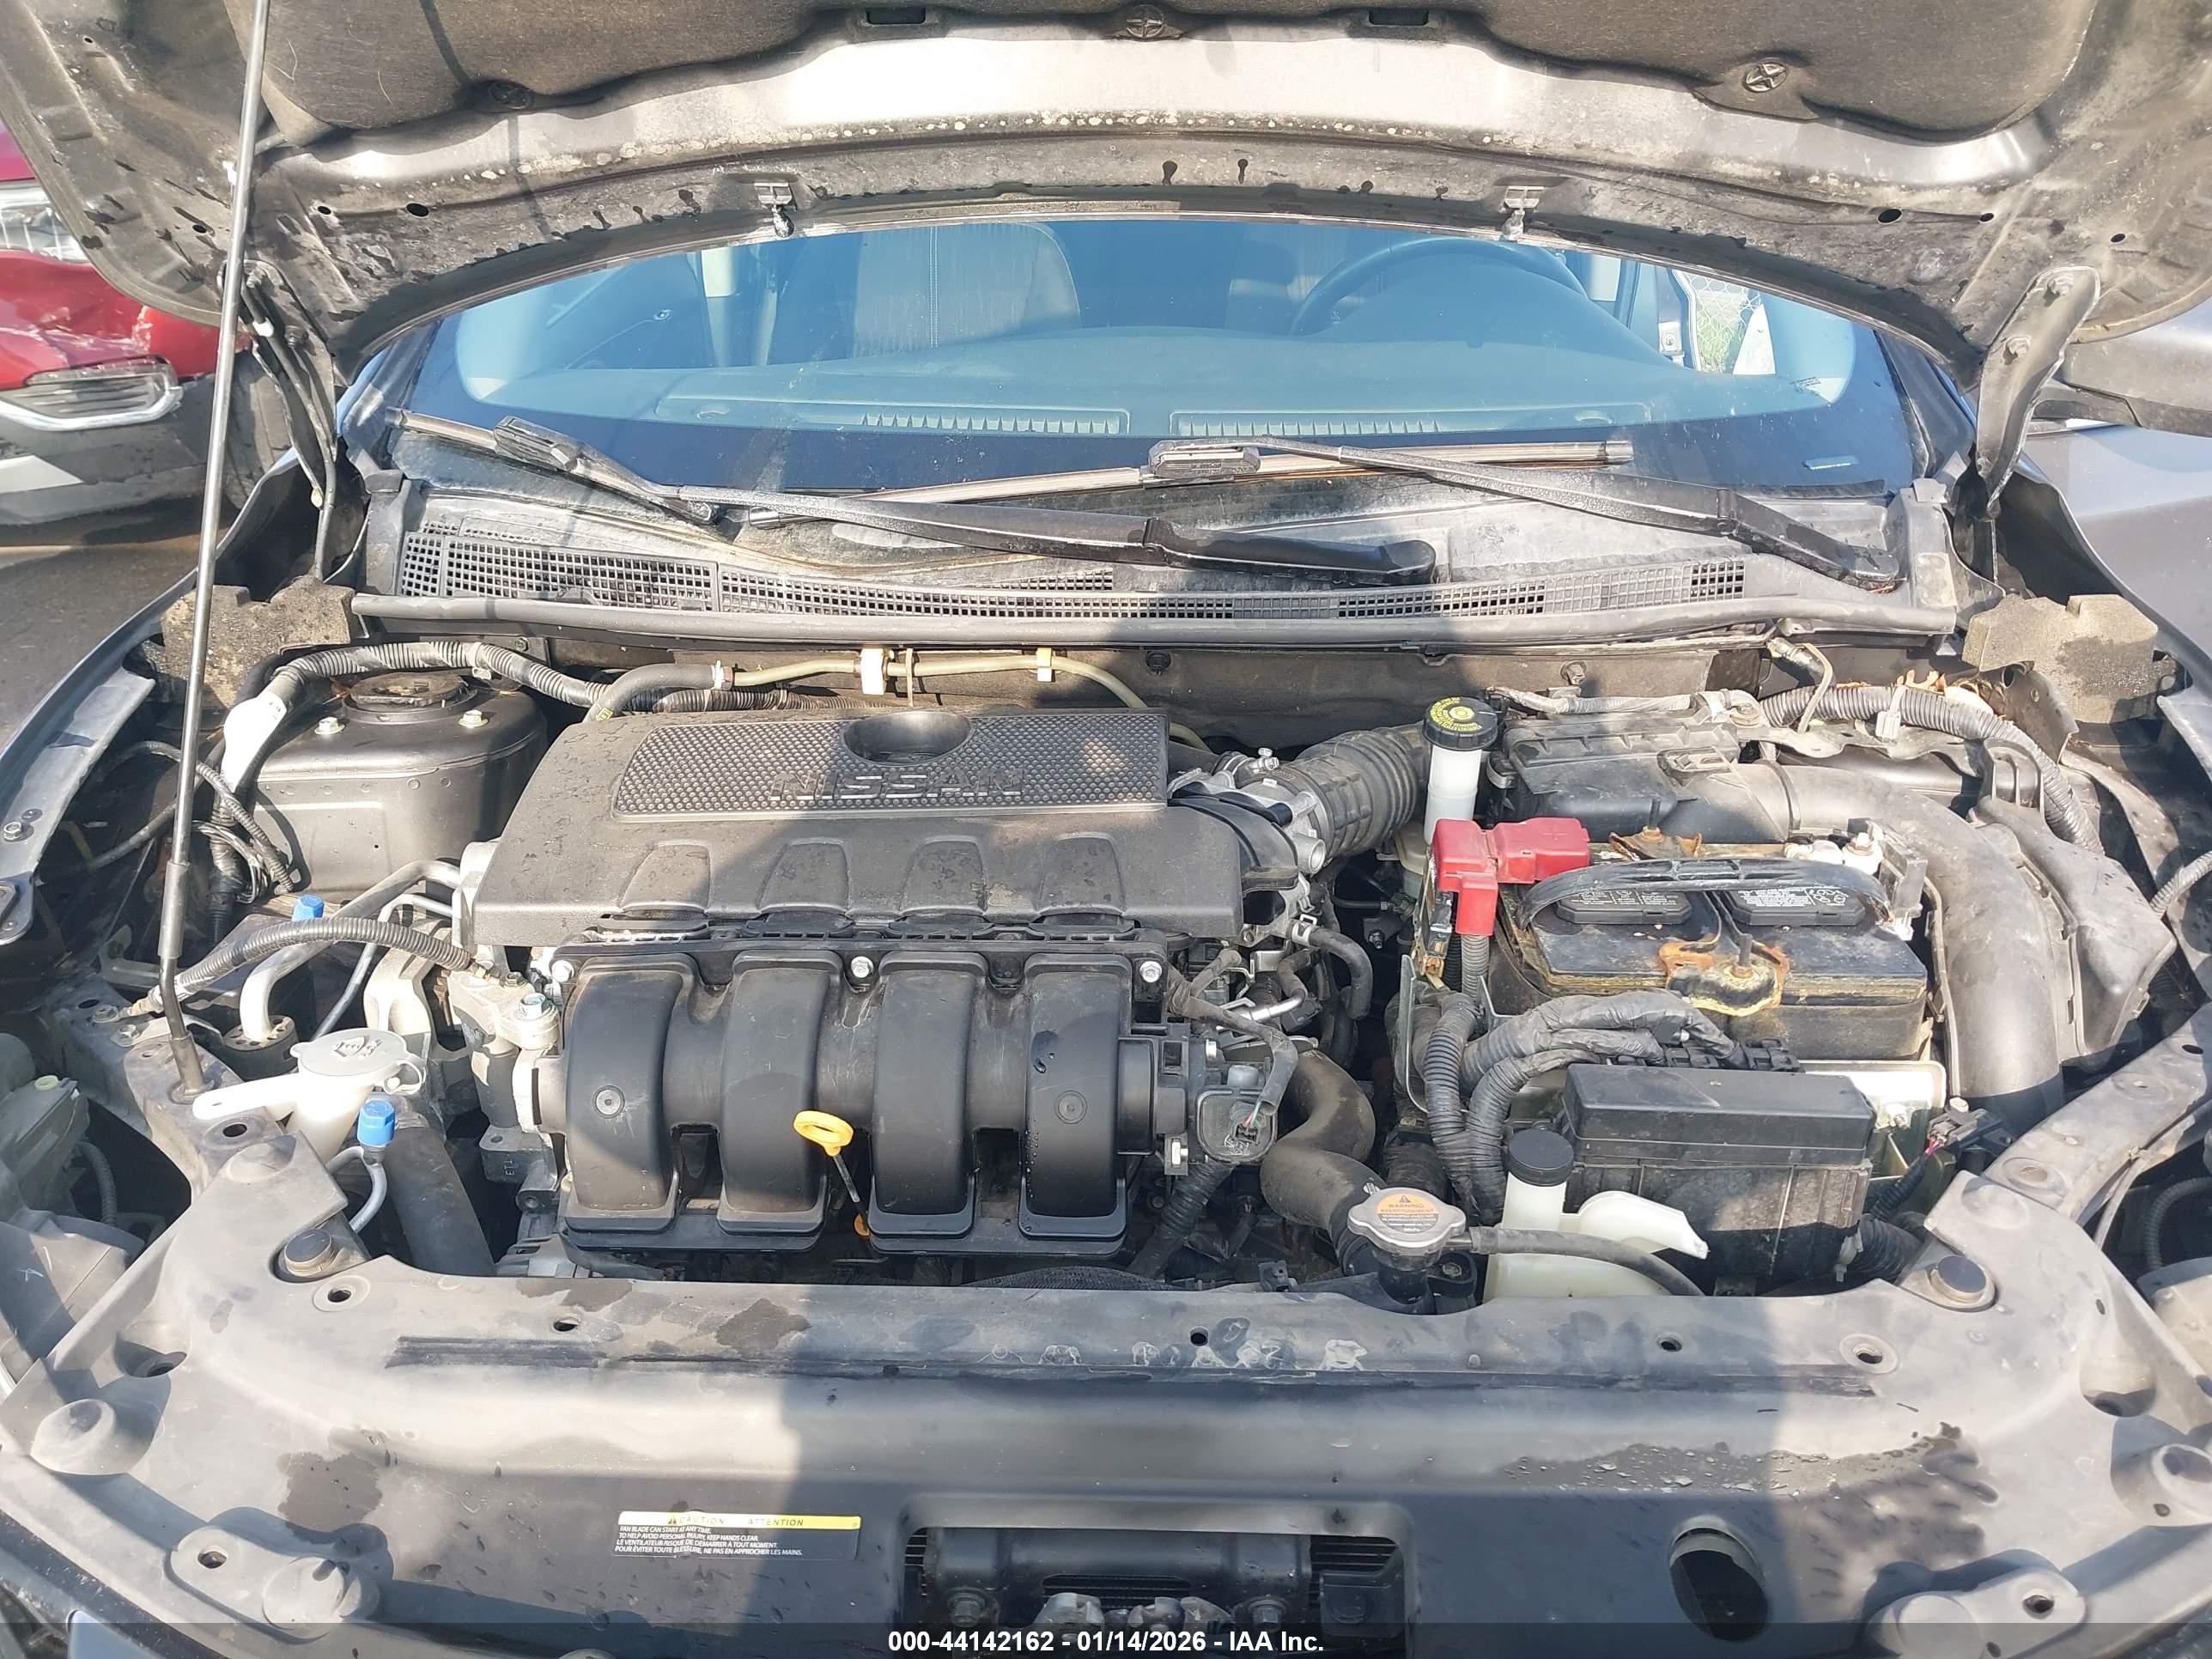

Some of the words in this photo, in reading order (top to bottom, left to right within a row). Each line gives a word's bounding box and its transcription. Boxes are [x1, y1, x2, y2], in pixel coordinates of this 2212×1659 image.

[769, 769, 1025, 799] NISSAN
[679, 1516, 725, 1525] CAUTION
[748, 1518, 804, 1527] ATTENTION
